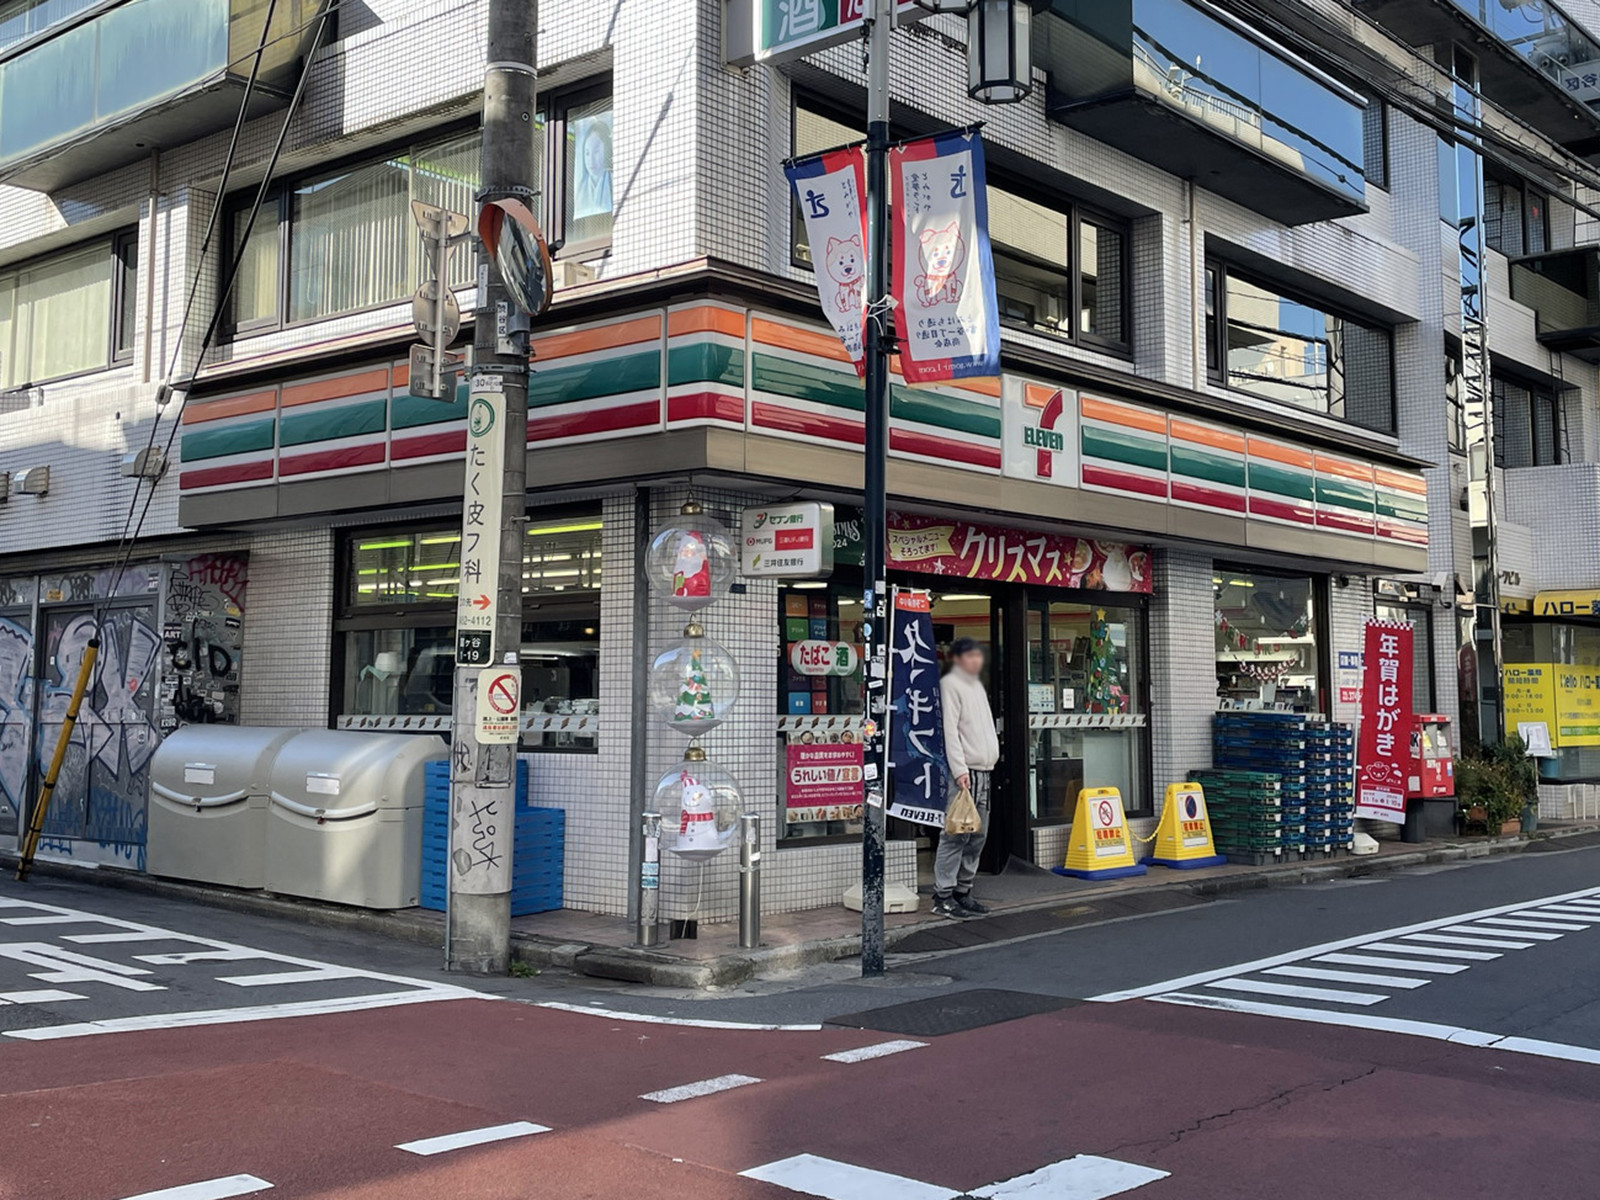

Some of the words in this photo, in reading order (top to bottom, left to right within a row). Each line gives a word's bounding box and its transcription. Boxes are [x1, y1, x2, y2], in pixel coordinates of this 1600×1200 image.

[464, 443, 486, 585] たく皮フ科
[769, 513, 804, 525] セブン銀行
[756, 537, 773, 545] MUFG
[892, 532, 946, 544] スペシャルメニュー
[764, 558, 804, 568] 三井住友銀行
[960, 526, 1063, 583] クリスマス
[800, 645, 831, 666] たばこ
[836, 647, 849, 667] 酒
[1376, 633, 1401, 757] 年賀はがき
